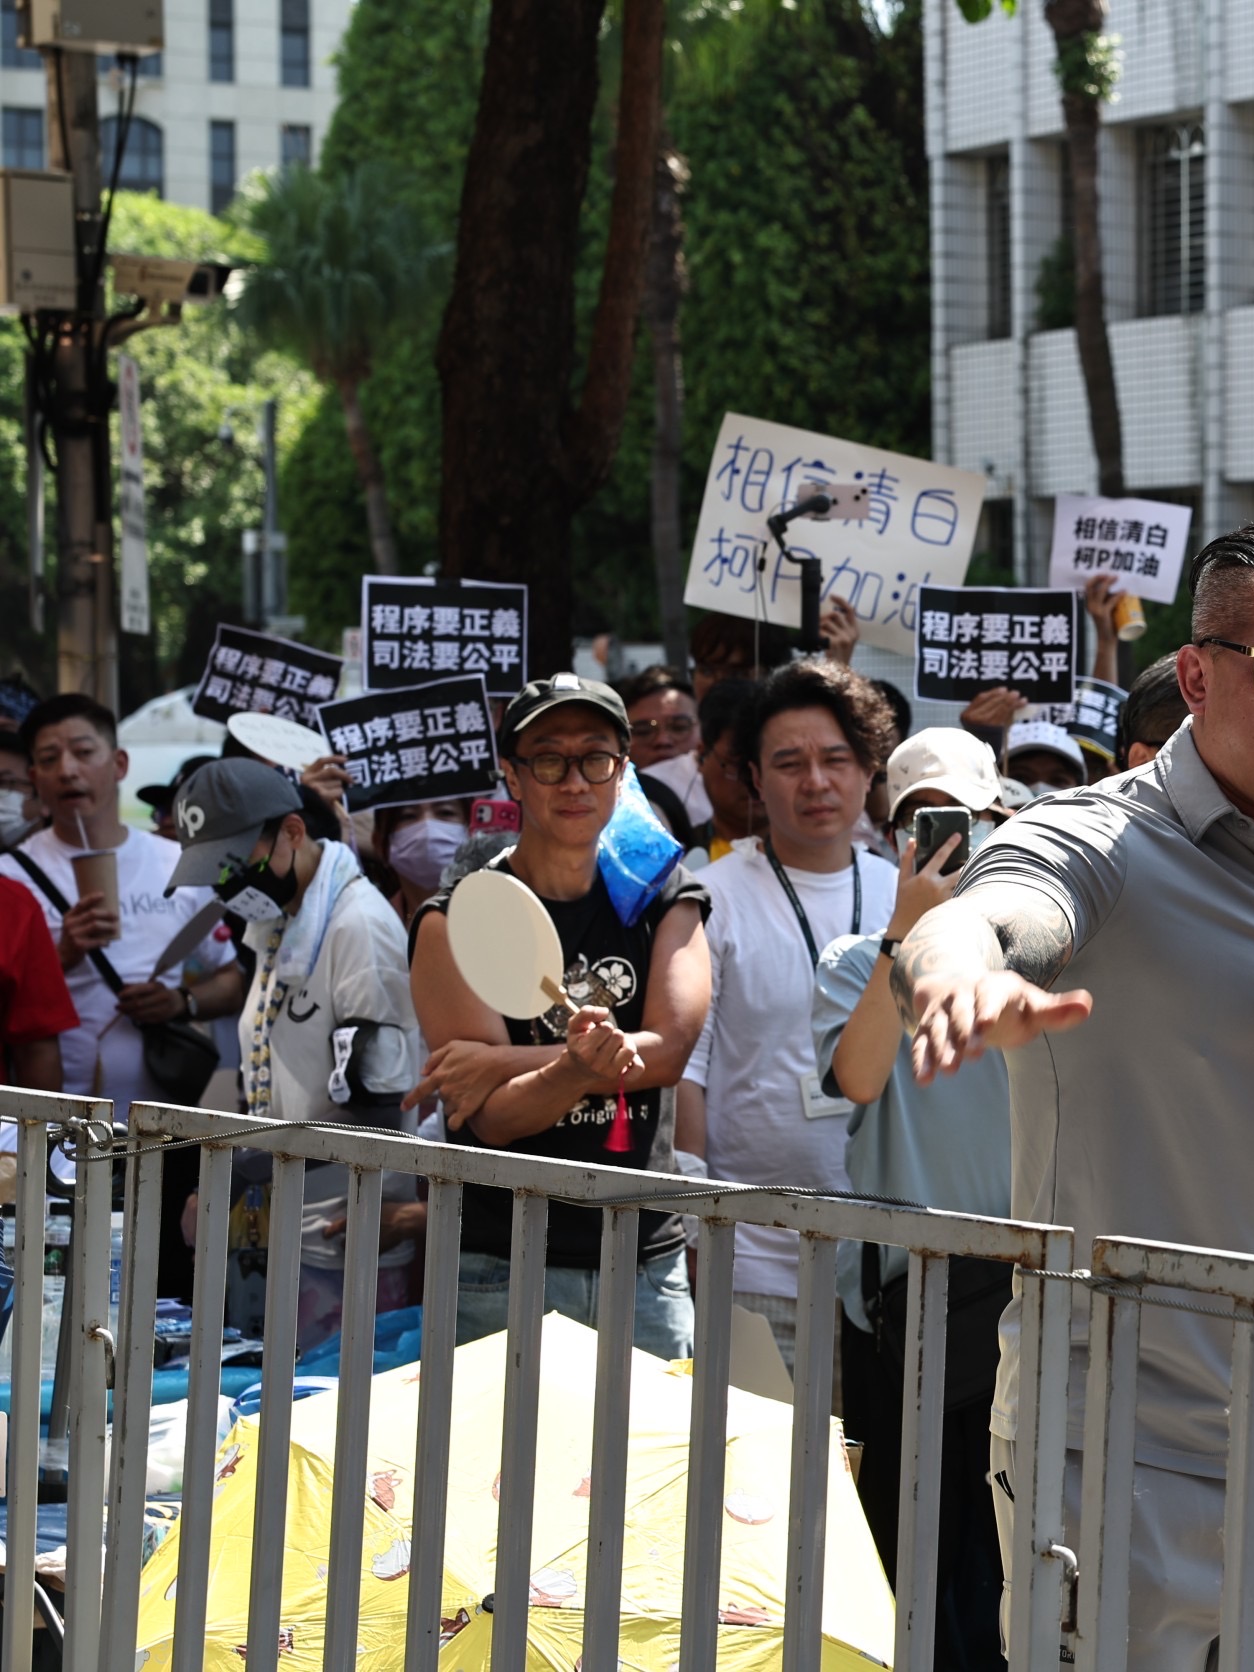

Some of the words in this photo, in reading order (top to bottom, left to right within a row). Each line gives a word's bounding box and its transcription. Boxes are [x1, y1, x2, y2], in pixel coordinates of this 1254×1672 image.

[1073, 516, 1168, 549] 相信清白
[1072, 546, 1161, 578] 柯P加油
[370, 603, 521, 639] 程序要正義
[922, 610, 1070, 646] 程序要正義
[213, 645, 336, 699] 程序要正義
[371, 639, 521, 673] 司法要公平
[922, 646, 1069, 682] 司法要公平
[329, 700, 487, 755] 程序要正義
[343, 738, 491, 788] 司法要公平
[570, 1104, 634, 1126] Originl
